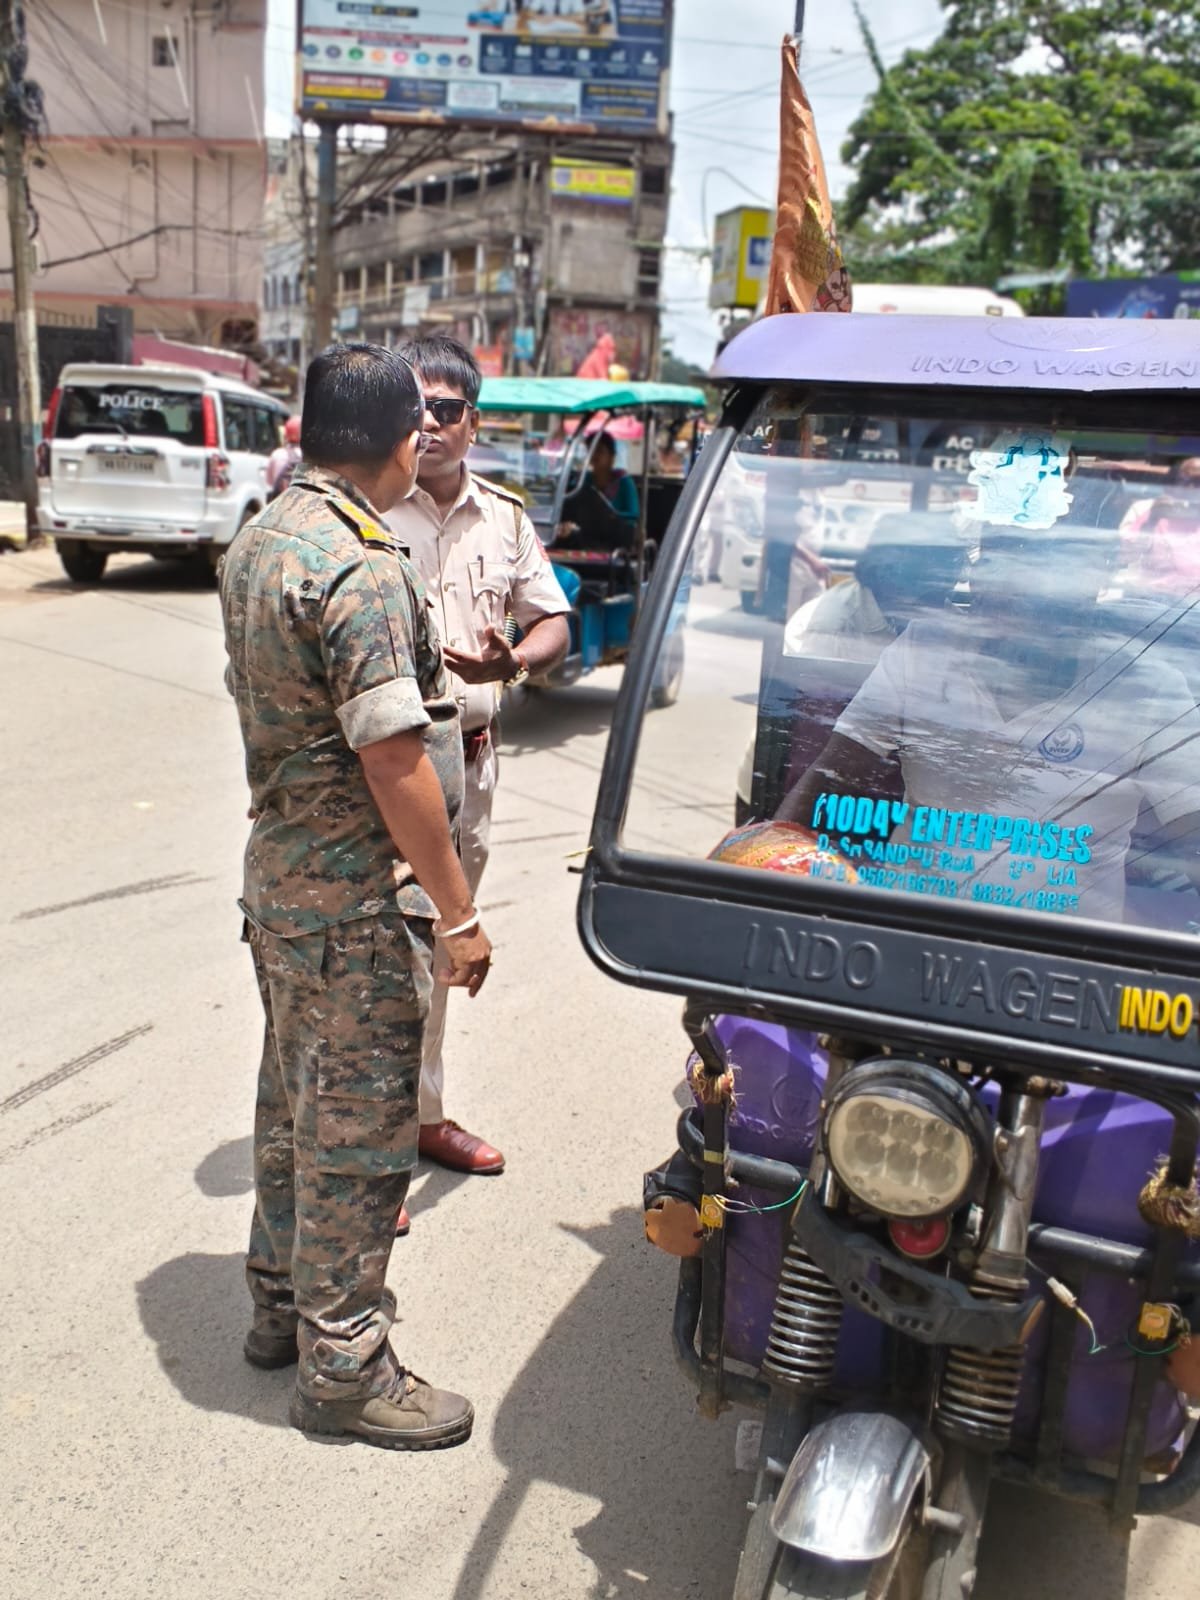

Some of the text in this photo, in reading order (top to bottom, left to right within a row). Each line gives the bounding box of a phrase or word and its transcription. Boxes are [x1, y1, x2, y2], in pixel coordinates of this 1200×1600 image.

[912, 356, 1198, 378] INDO WAGEN
[99, 393, 163, 410] POLICE
[946, 436, 974, 450] AC
[911, 806, 1093, 865] ENTERPRISES
[742, 923, 1124, 1034] INDO WAGEN
[1120, 985, 1193, 1037] INDO
